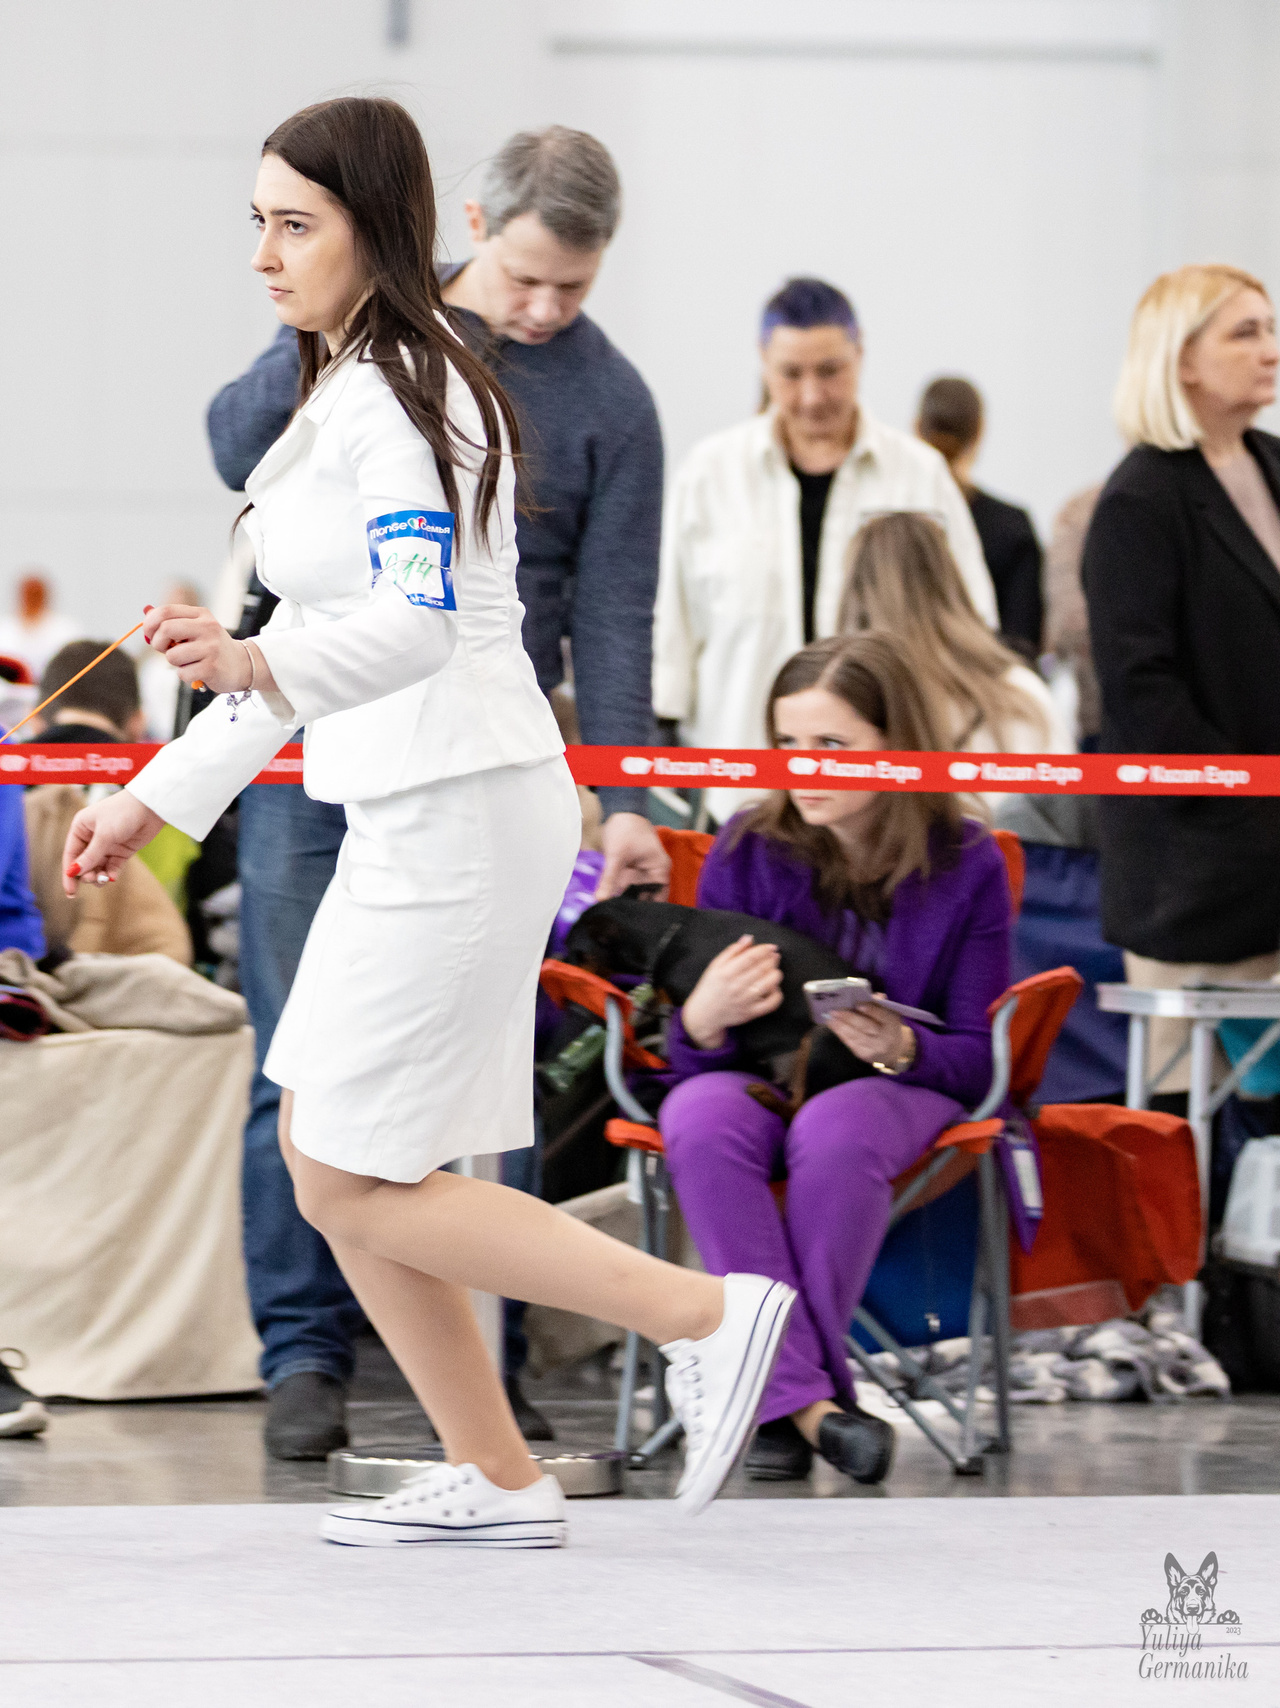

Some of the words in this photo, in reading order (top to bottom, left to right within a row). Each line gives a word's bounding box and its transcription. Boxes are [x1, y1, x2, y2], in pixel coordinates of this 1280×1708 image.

[86, 753, 134, 775] Expo
[709, 758, 757, 780] Expo
[875, 761, 922, 784] Expo
[1036, 762, 1083, 786] Expo
[1203, 765, 1250, 788] Expo
